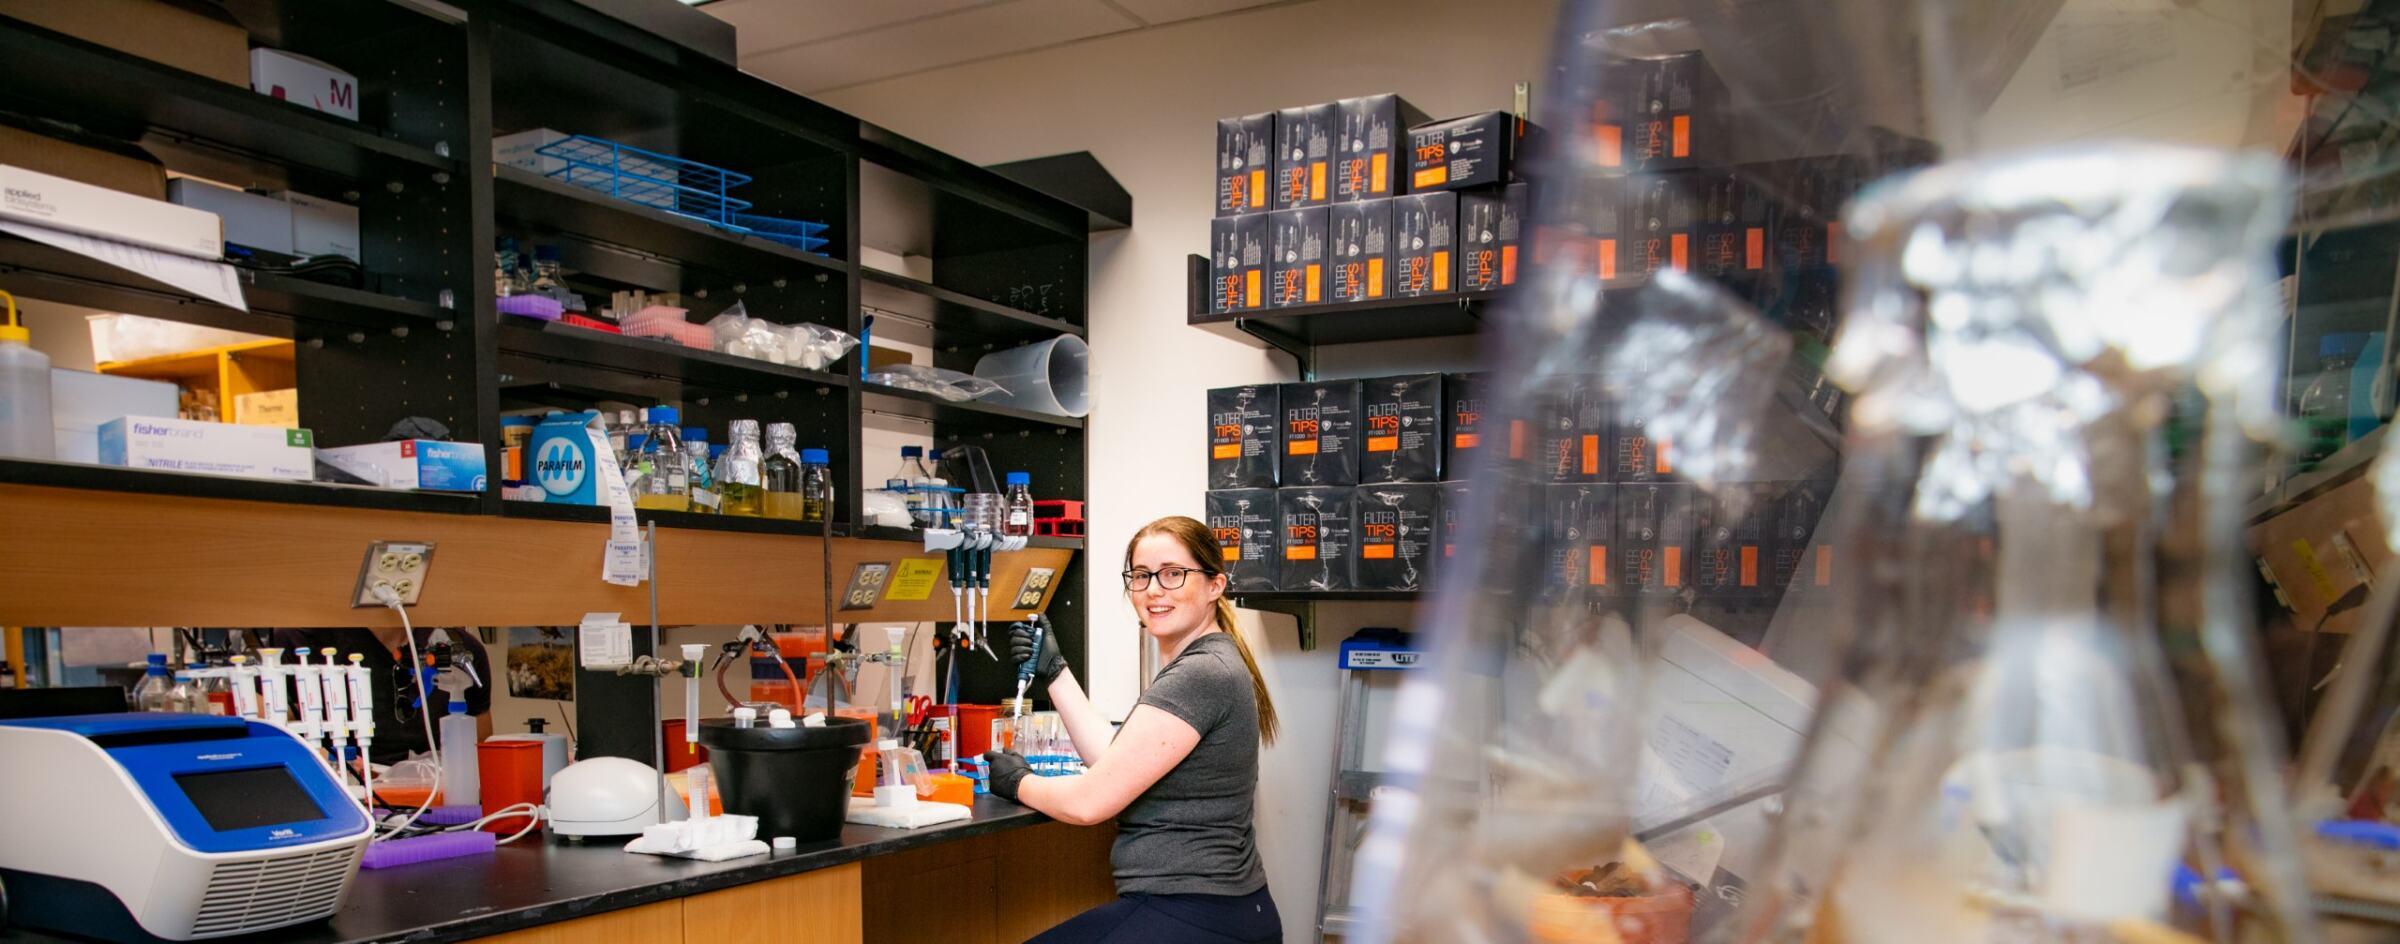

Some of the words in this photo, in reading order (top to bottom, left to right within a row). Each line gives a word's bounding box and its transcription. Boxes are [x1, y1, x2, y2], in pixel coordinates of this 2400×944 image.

[329, 78, 352, 110] M
[1416, 130, 1444, 148] FILTER
[1416, 143, 1444, 160] TIPS
[1280, 168, 1291, 202] FILTER
[1291, 167, 1303, 201] TIPS
[1339, 160, 1351, 194] FILTER
[1351, 159, 1363, 191] TIPS
[1221, 177, 1231, 210] FILTER
[1232, 176, 1243, 207] TIPS
[1336, 264, 1347, 298] FILTER
[1347, 263, 1359, 297] TIPS
[1399, 258, 1410, 292] FILTER
[1411, 256, 1424, 290] TIPS
[1466, 251, 1479, 286] FILTER
[1479, 250, 1492, 285] TIPS
[1216, 276, 1227, 309] FILTER
[1227, 275, 1238, 305] TIPS
[1274, 271, 1285, 304] FILTER
[1285, 269, 1297, 301] TIPS
[1214, 412, 1240, 426] FILTER
[1289, 408, 1318, 421] FILTER
[1368, 403, 1398, 417] FILTER
[1369, 415, 1398, 429] TIPS
[1215, 424, 1240, 437] TIPS
[1290, 420, 1318, 433] TIPS
[537, 460, 582, 471] PARAFILM
[1632, 436, 1645, 471] TIPS
[1212, 515, 1240, 528] FILTER
[1213, 527, 1240, 539] TIPS
[1287, 514, 1316, 526] FILTER
[1288, 525, 1316, 538] TIPS
[1364, 511, 1395, 524] FILTER
[1365, 524, 1395, 537] TIPS
[1640, 549, 1653, 583] TIPS
